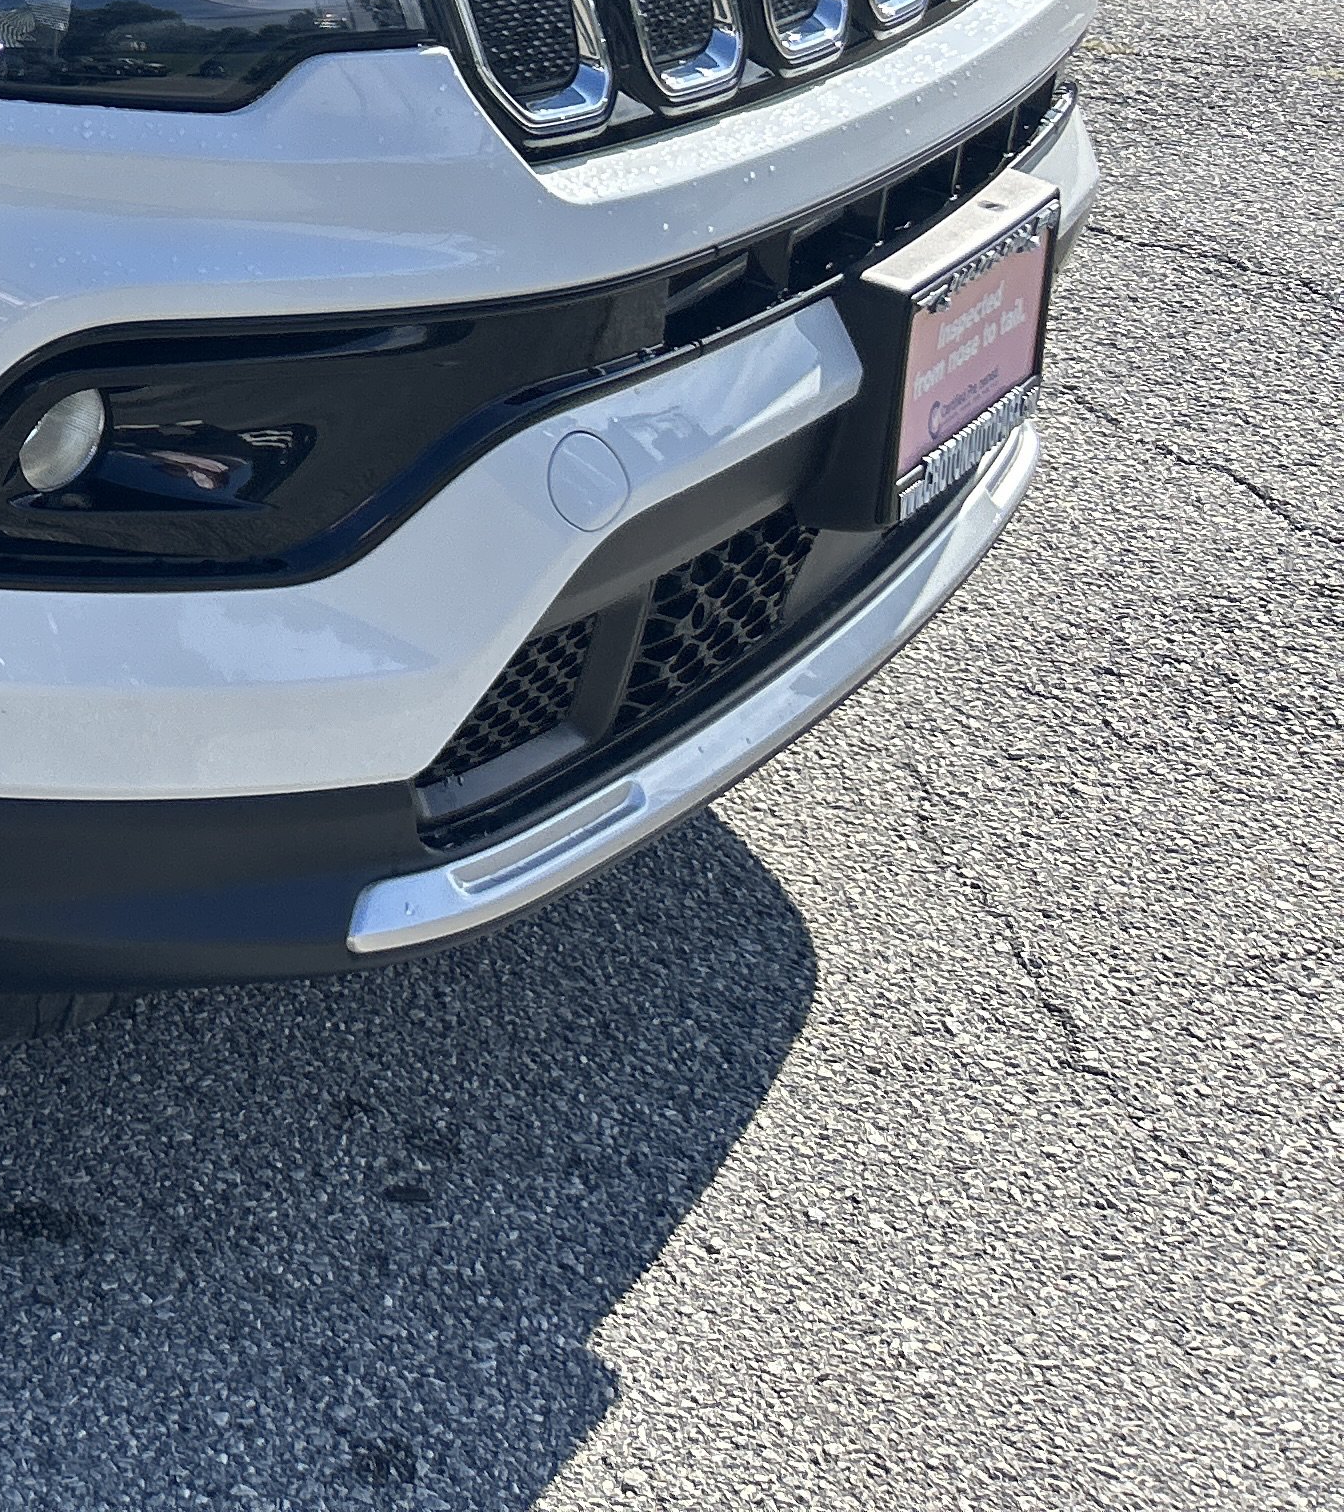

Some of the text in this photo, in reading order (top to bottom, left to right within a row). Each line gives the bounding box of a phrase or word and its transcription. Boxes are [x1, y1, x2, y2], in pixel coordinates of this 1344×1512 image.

[937, 279, 1005, 349] Inspected
[914, 359, 945, 400] from
[947, 335, 980, 374] nose
[983, 321, 997, 347] to
